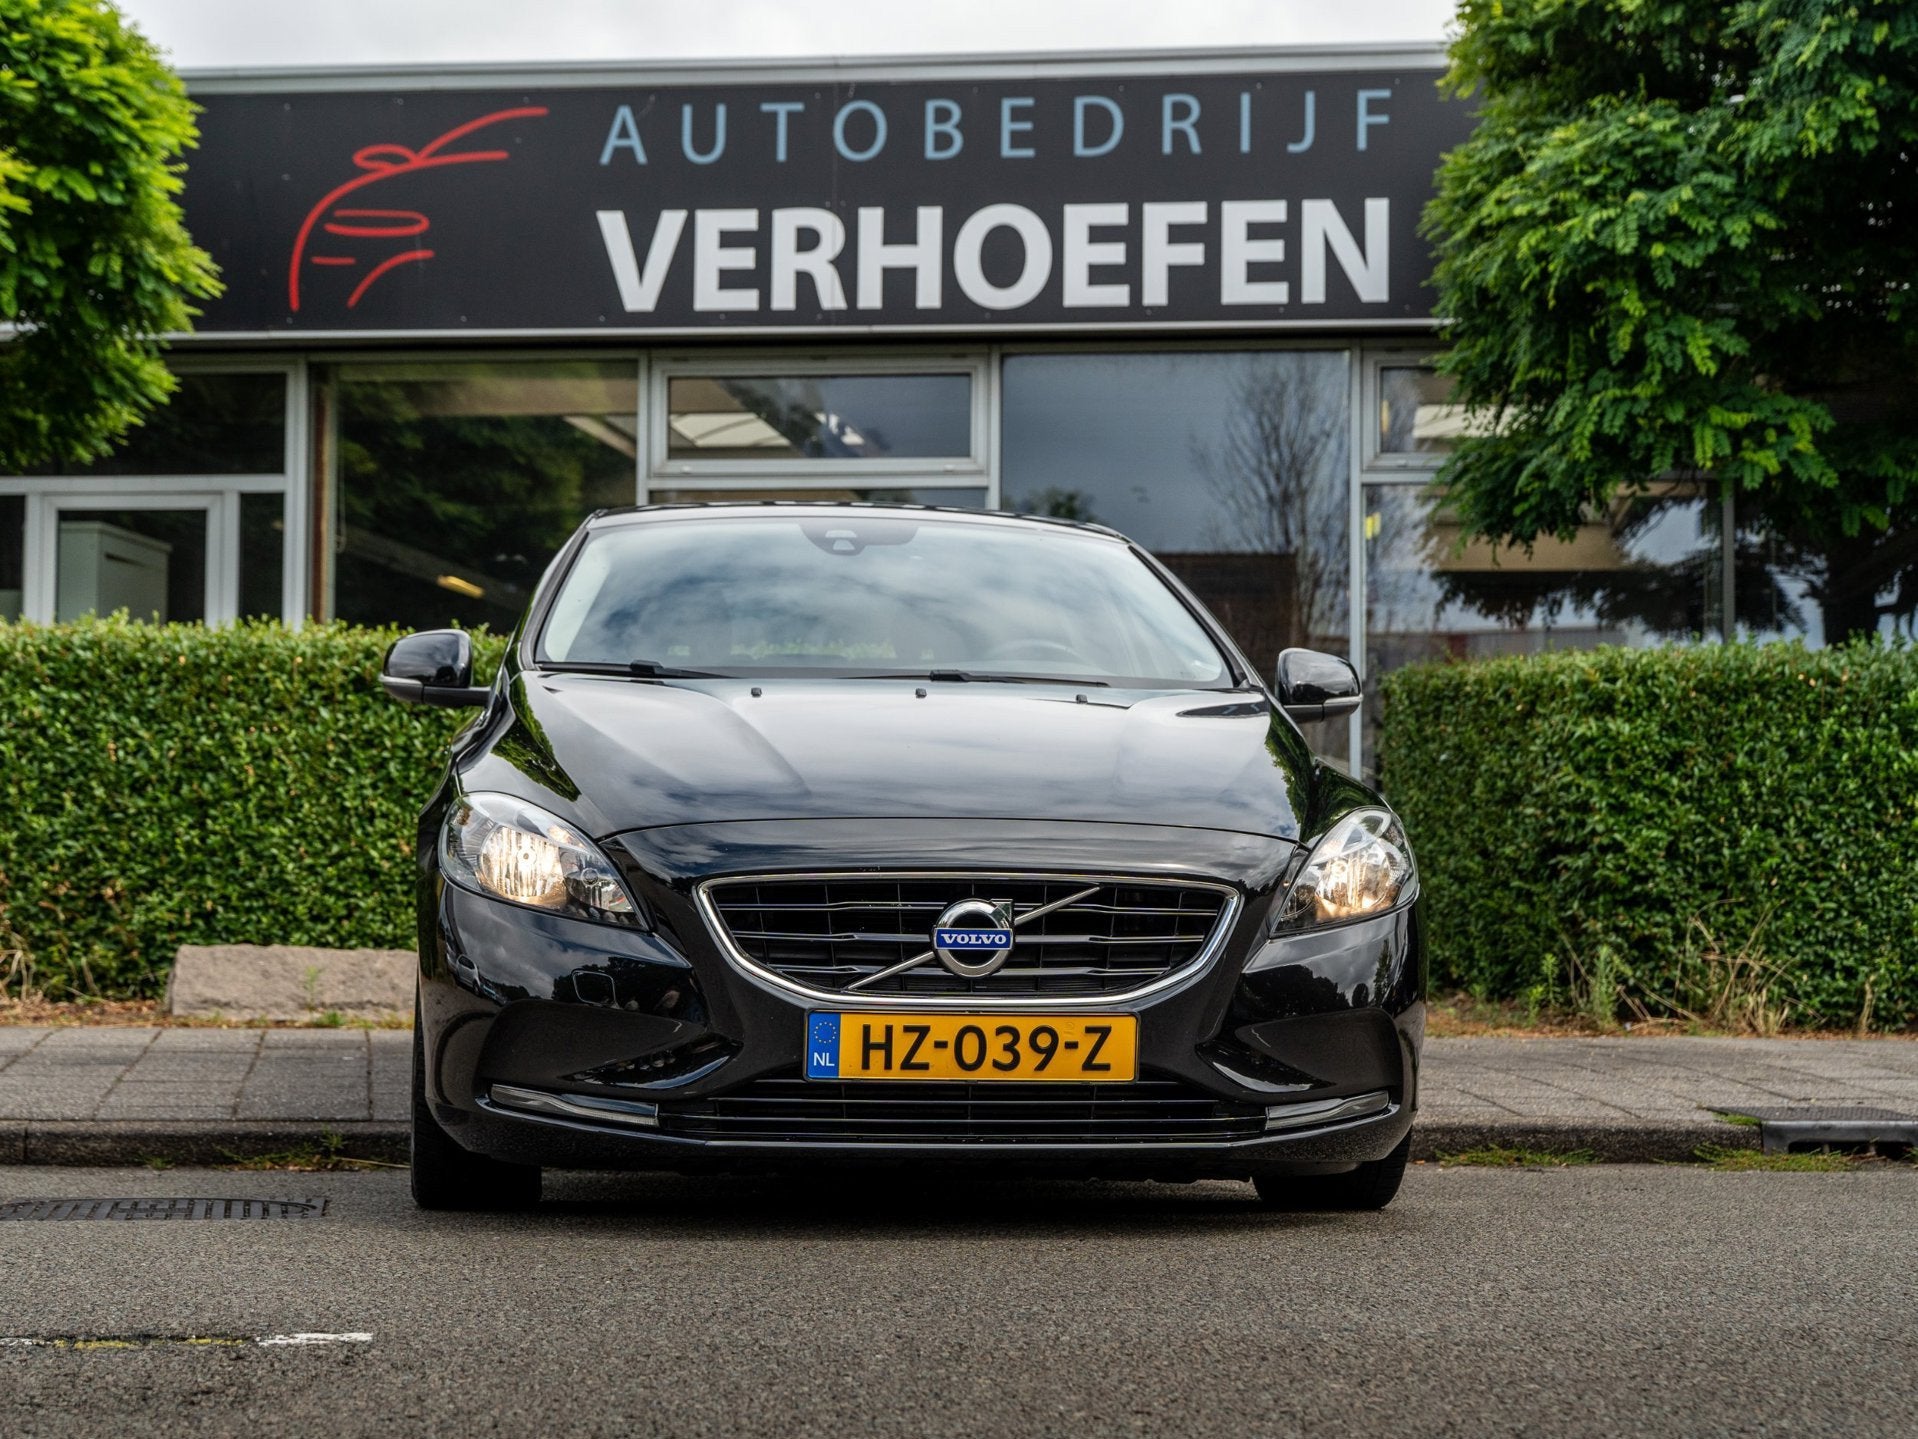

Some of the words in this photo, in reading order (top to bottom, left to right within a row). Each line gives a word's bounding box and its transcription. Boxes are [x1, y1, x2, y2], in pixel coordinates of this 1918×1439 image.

[599, 88, 1392, 165] AUTOBEDRIJF
[596, 197, 1390, 312] VERHOEFEN
[941, 933, 1007, 945] VOLVO
[813, 1052, 835, 1067] NL
[861, 1024, 1112, 1072] HZ-039-Z
